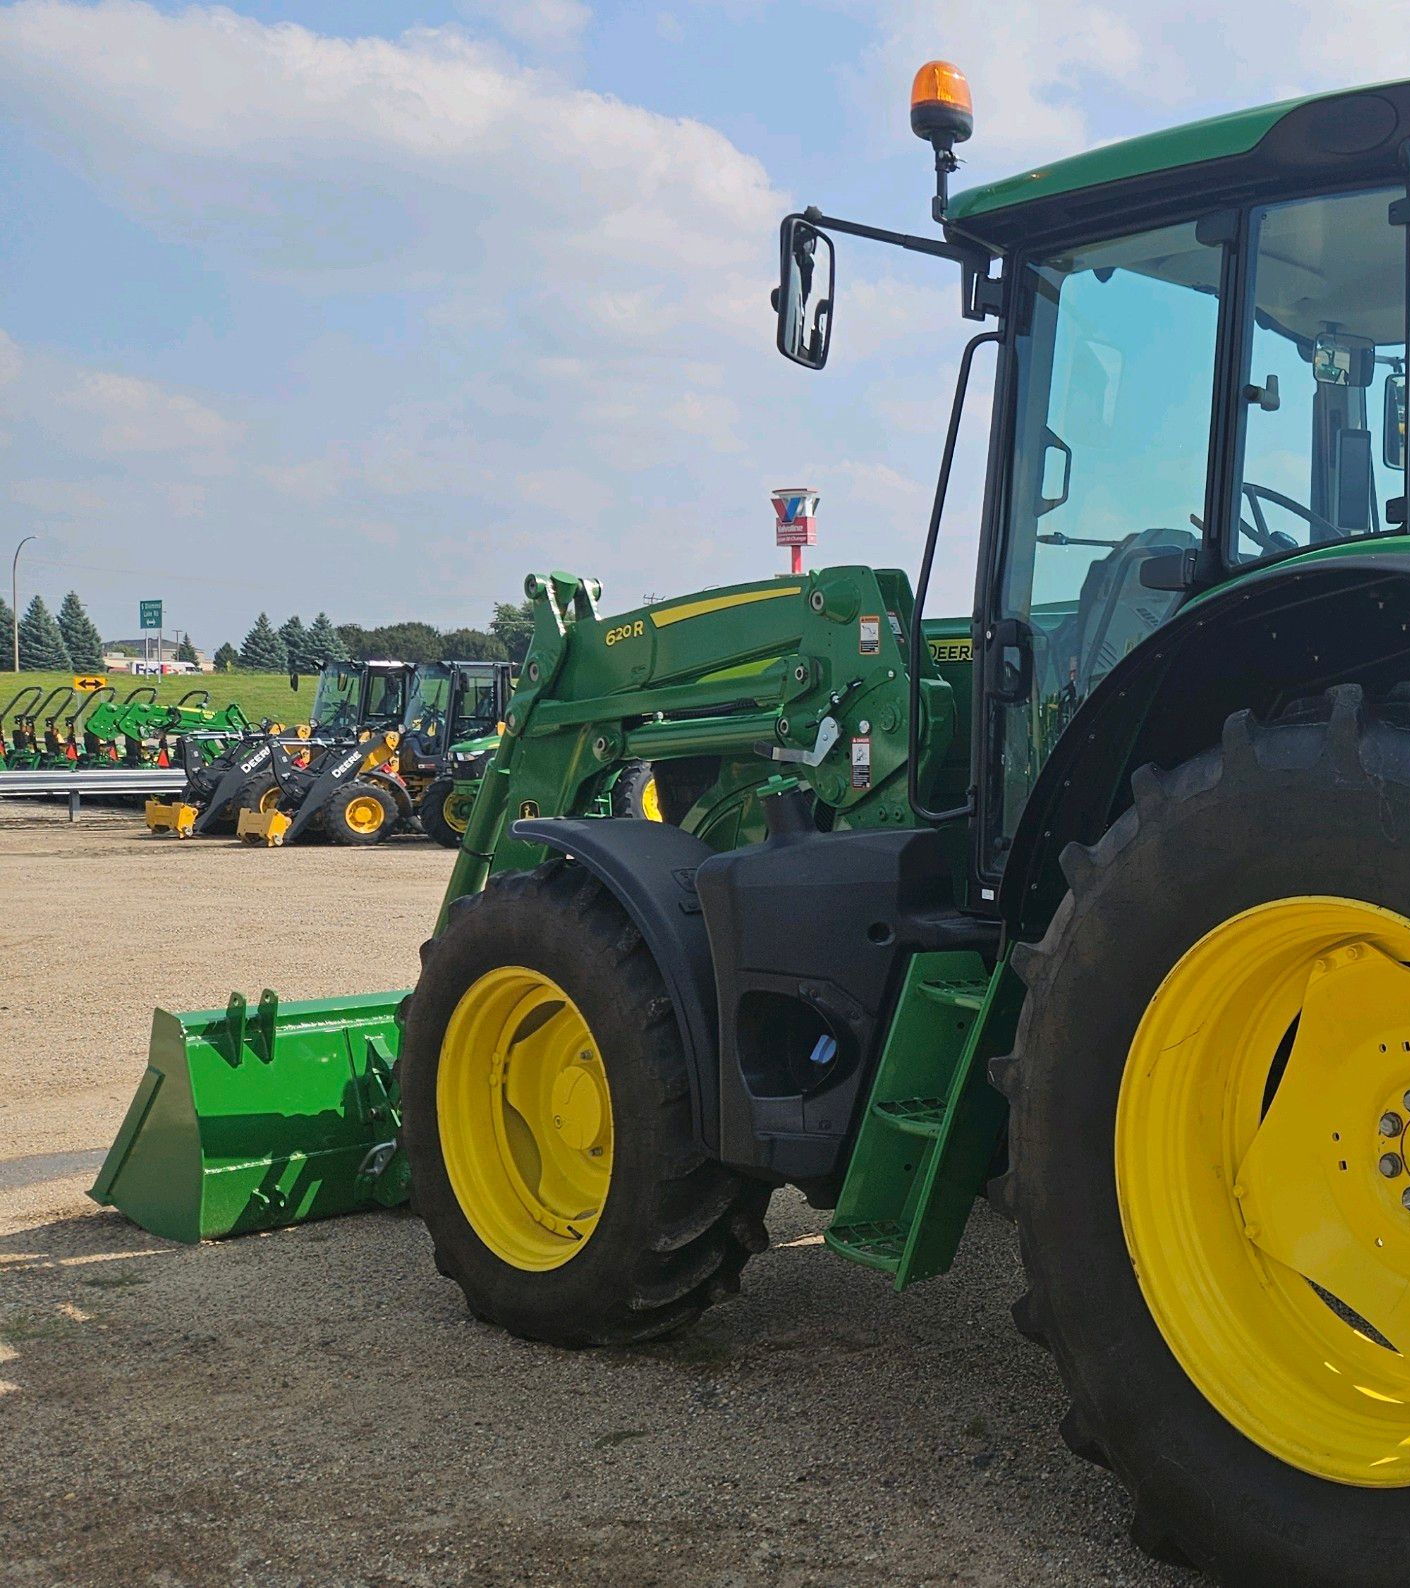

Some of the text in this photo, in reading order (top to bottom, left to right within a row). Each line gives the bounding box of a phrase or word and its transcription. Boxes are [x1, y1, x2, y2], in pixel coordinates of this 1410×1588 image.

[606, 620, 644, 646] 620 R
[928, 644, 973, 660] DEER
[331, 750, 362, 779] DEERE
